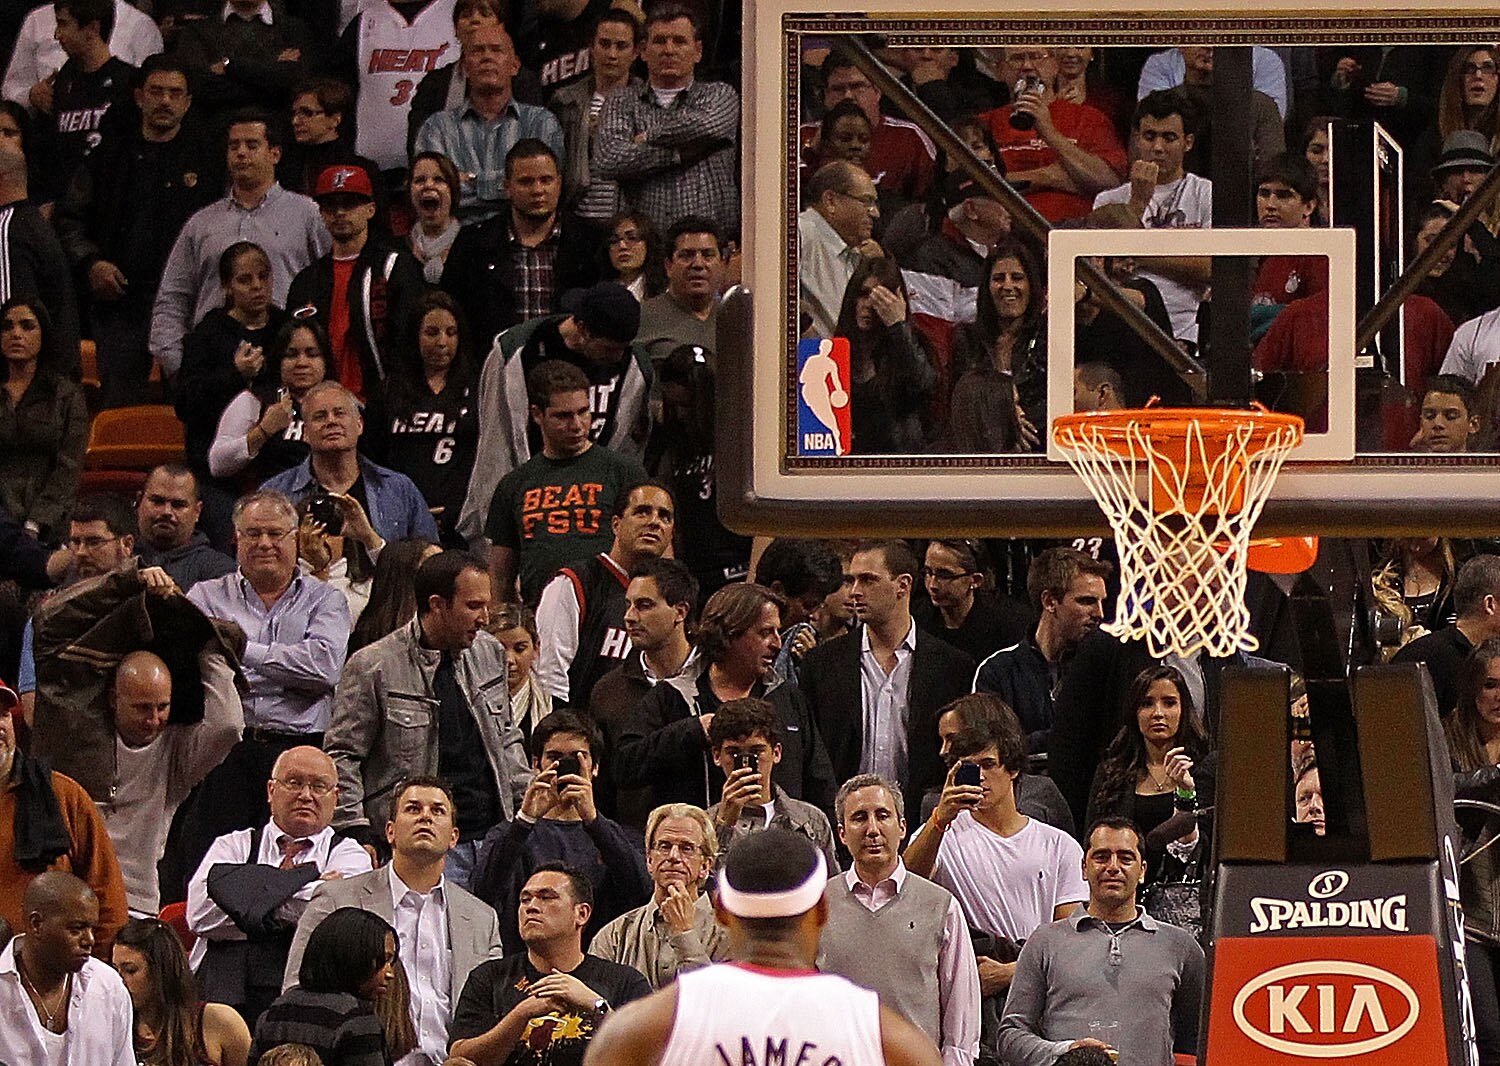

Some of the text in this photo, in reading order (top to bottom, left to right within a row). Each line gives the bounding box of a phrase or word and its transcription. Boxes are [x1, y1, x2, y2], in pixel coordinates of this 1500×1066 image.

[367, 42, 450, 74] HEAT
[540, 47, 591, 87] HEA
[58, 102, 112, 133] HEAT
[391, 407, 469, 434] HEAT
[433, 437, 456, 466] 6
[804, 433, 834, 451] NBA
[522, 482, 603, 513] BEAT
[522, 508, 602, 539] FSU
[1250, 894, 1408, 933] SPALDING
[1266, 984, 1390, 1033] KIA
